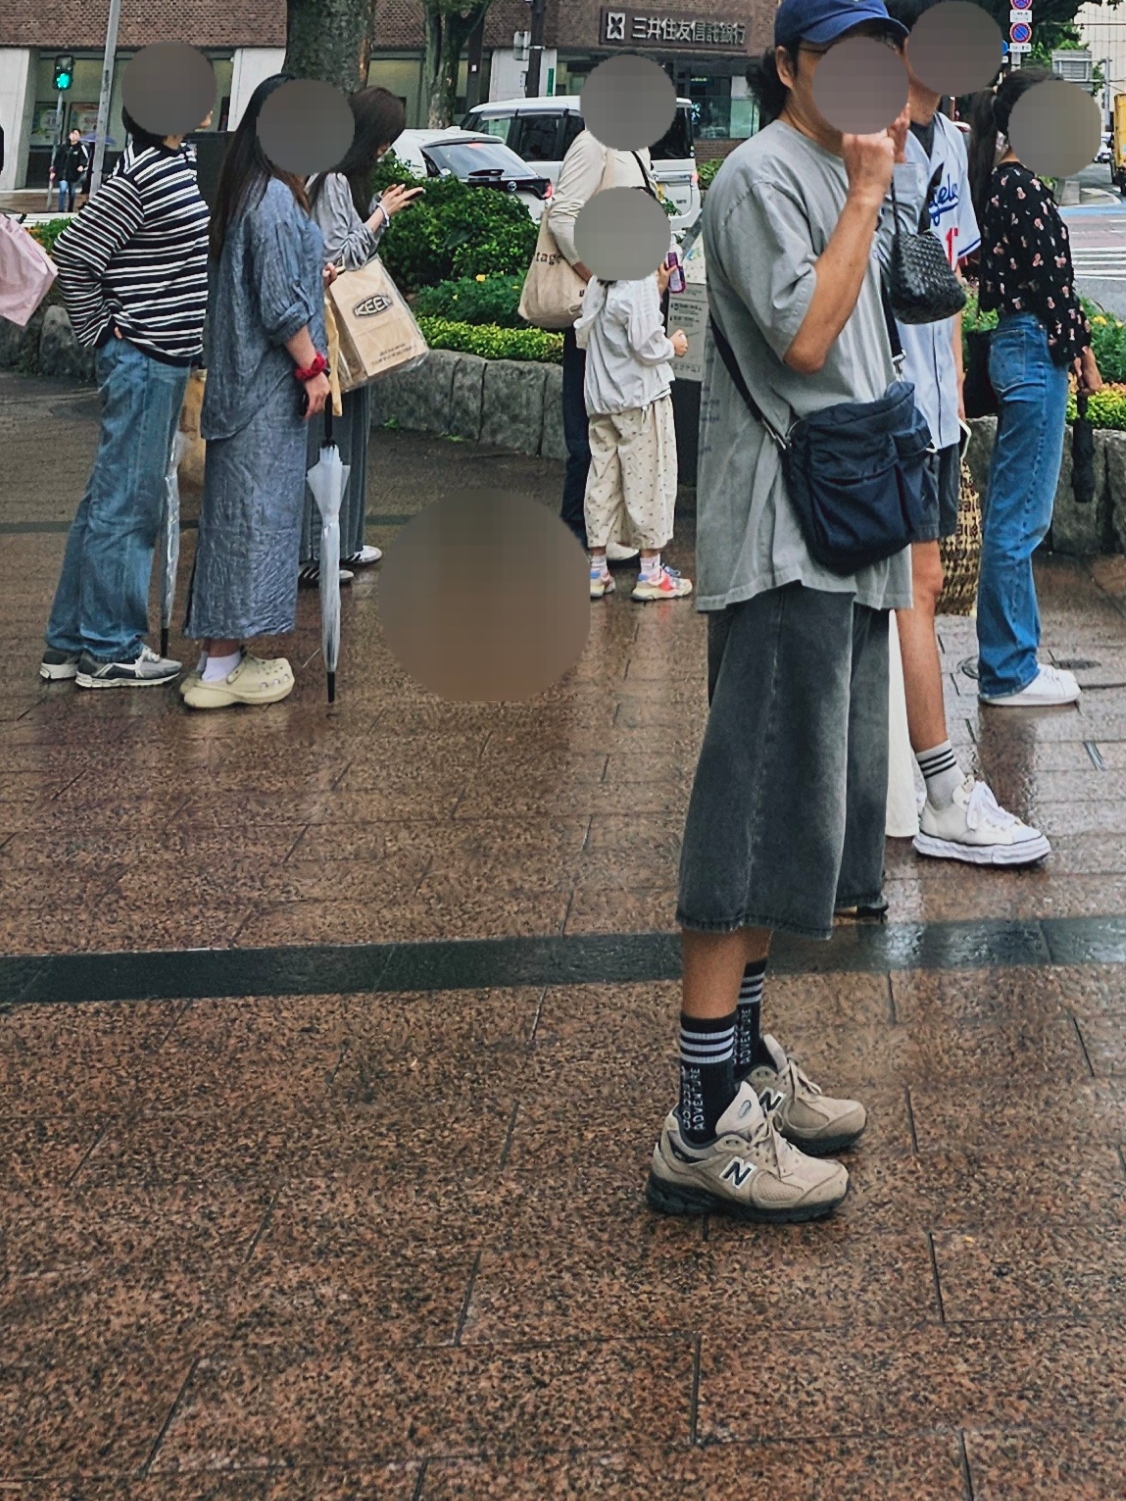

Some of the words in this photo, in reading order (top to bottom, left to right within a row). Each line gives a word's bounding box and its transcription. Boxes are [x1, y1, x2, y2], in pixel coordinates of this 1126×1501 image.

[632, 17, 746, 45] 三井住友信託銀行
[354, 295, 392, 316] KEEN
[691, 1067, 705, 1131] ADVENTURE
[721, 1158, 756, 1188] N
